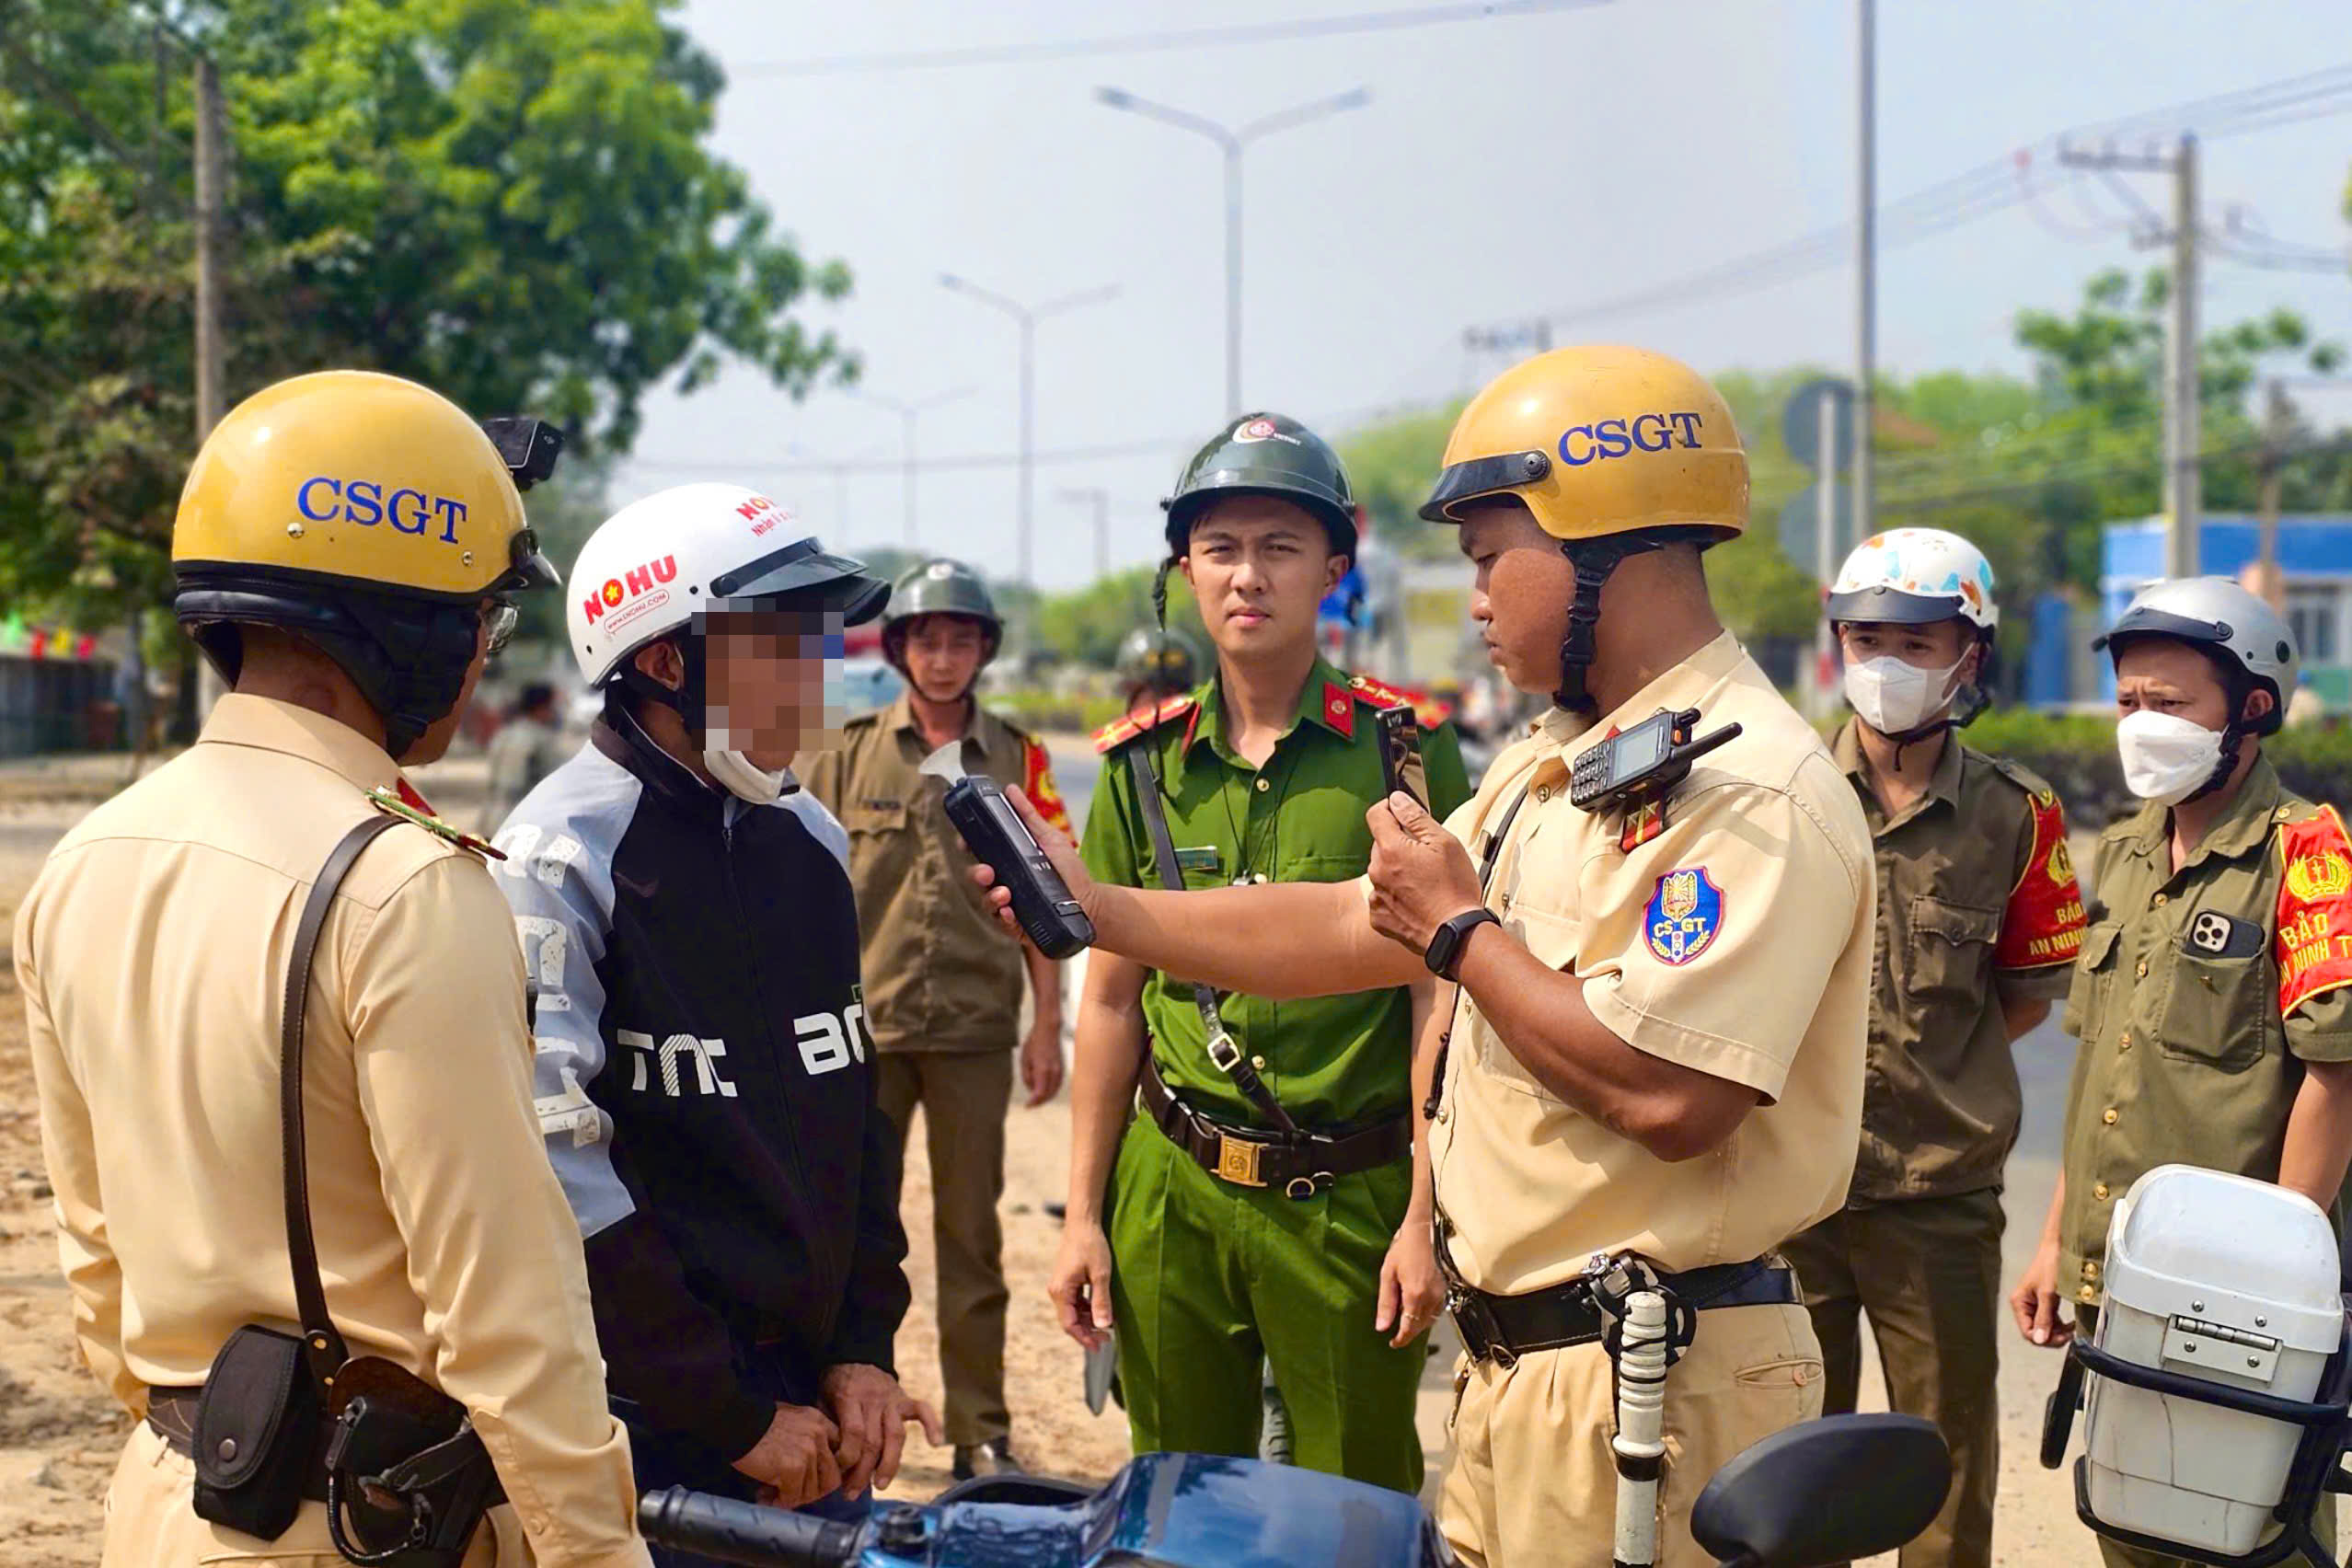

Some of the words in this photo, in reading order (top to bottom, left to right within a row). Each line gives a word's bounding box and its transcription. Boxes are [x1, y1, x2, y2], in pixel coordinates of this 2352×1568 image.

[1558, 412, 1702, 467] CSGT
[298, 477, 467, 544] CSGT
[583, 555, 677, 626] NOHU
[2029, 939, 2051, 956] AN
[2279, 910, 2328, 950] BẢO
[2292, 939, 2331, 973] NINH
